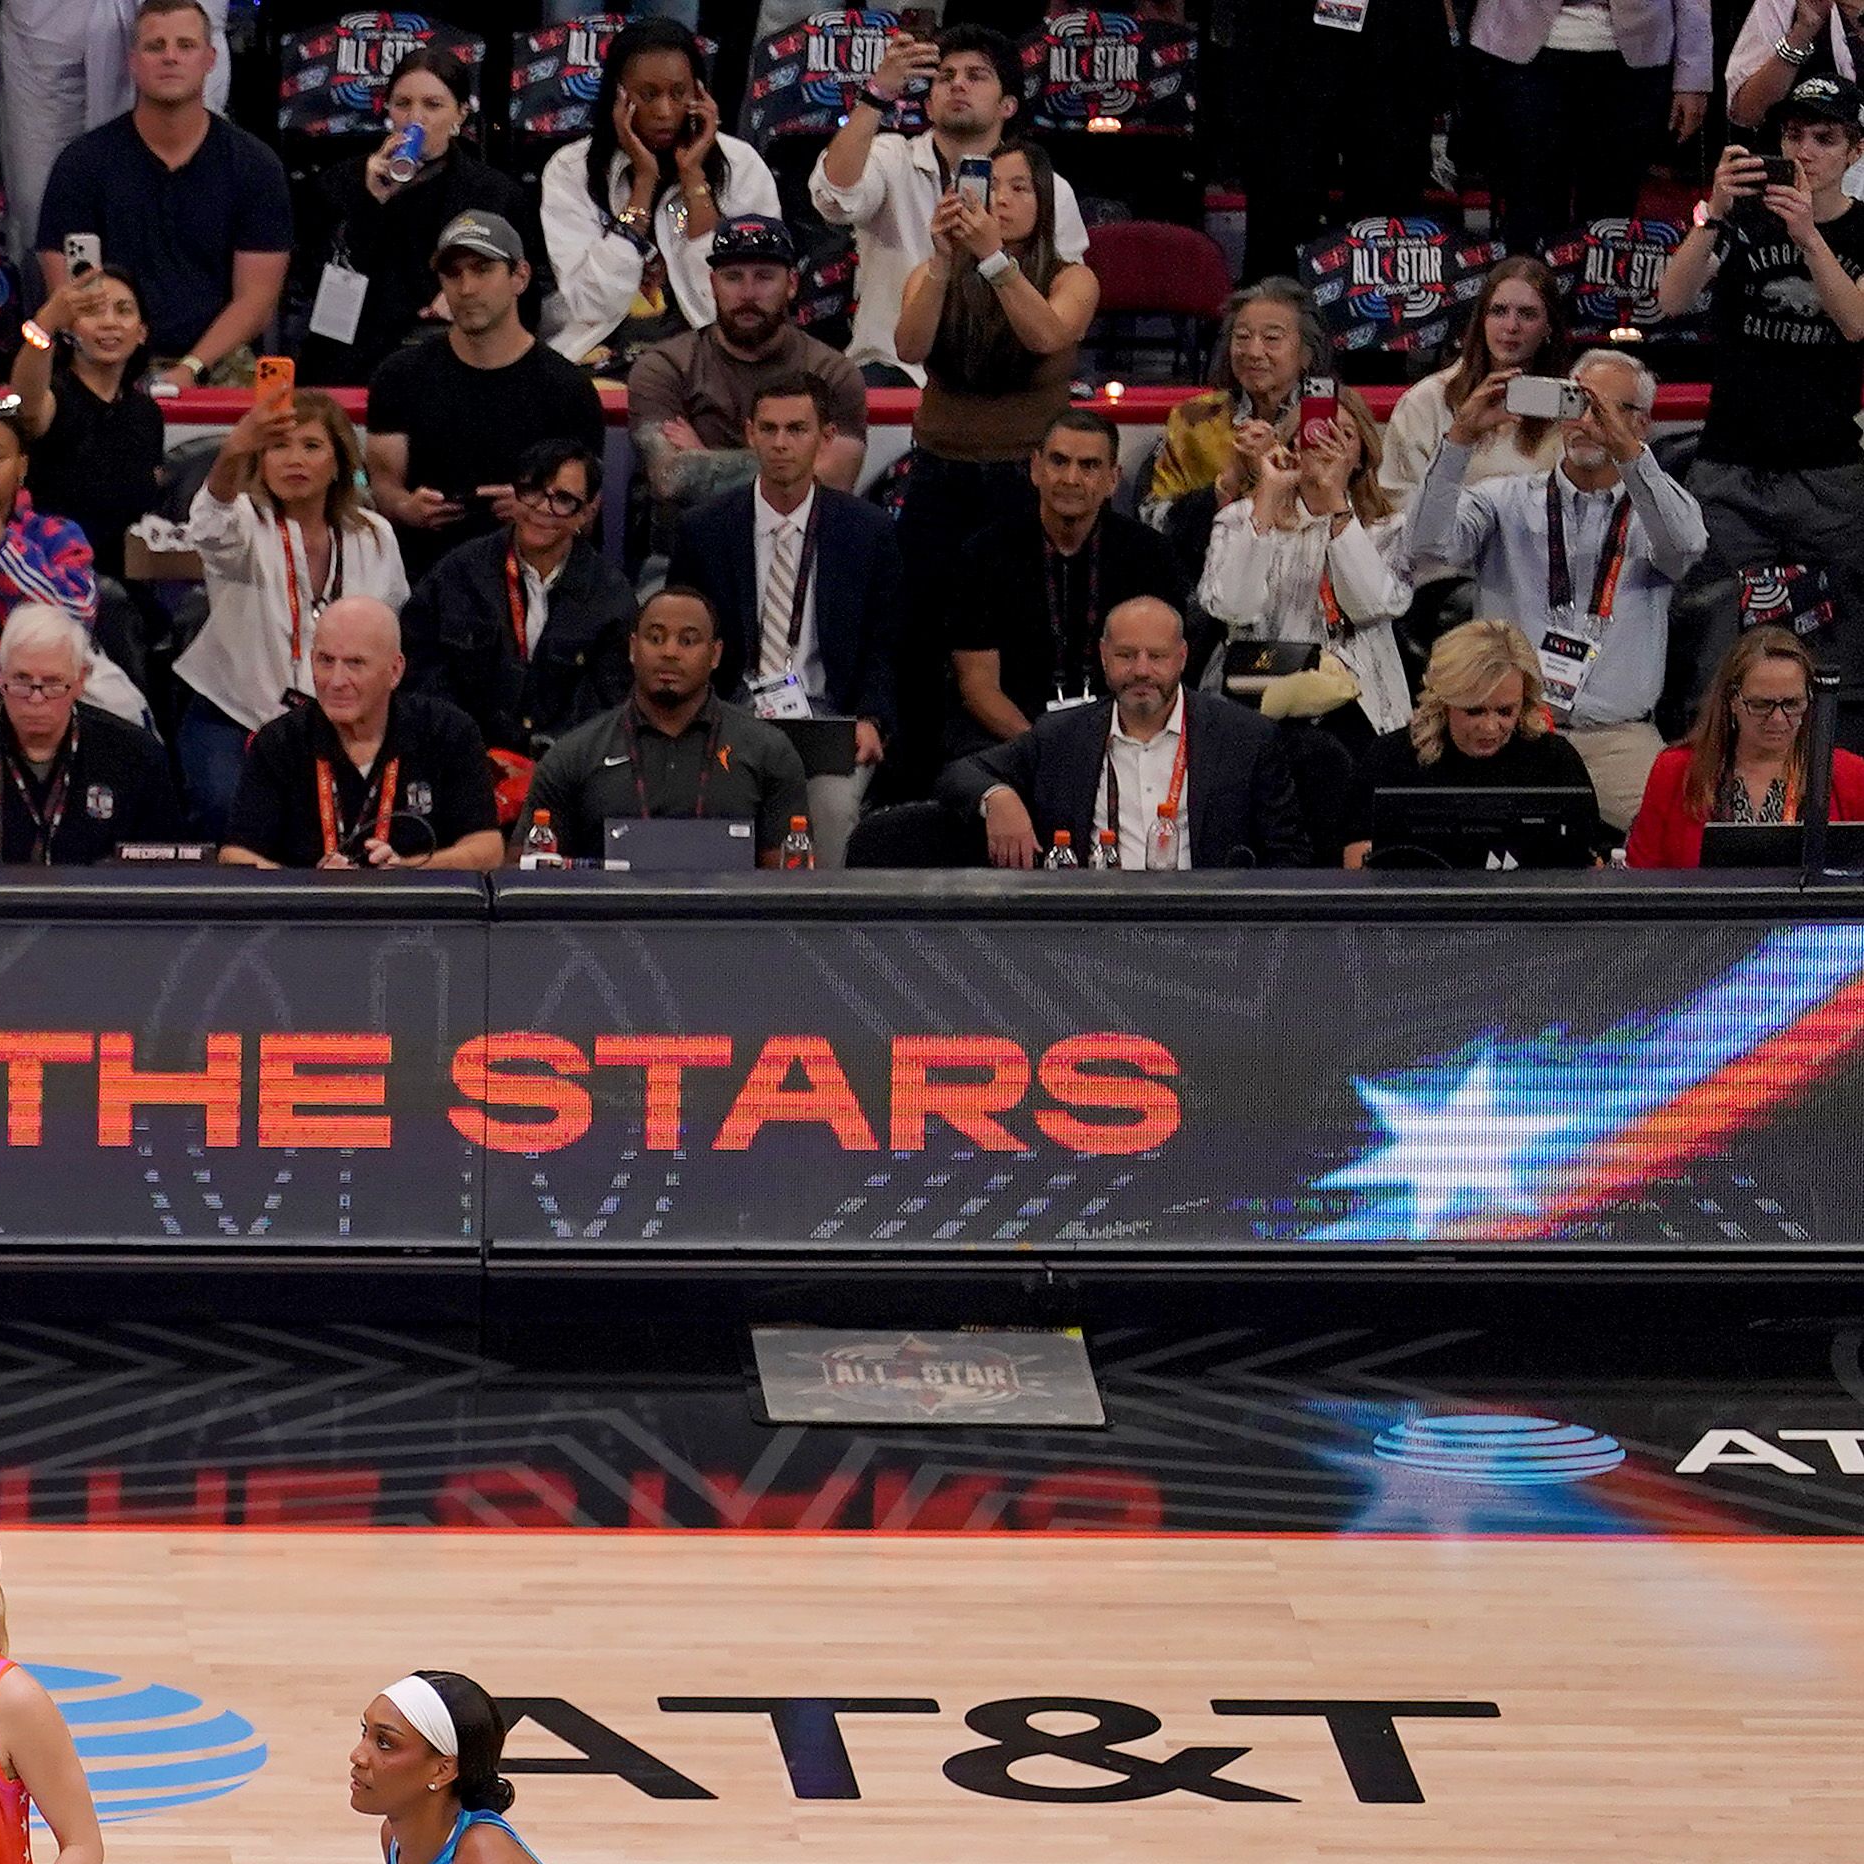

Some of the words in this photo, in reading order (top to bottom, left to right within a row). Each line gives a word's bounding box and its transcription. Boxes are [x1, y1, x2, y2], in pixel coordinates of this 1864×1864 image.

[1049, 46, 1082, 82] ALL
[1093, 46, 1139, 82] STAR
[1353, 246, 1384, 284] ALL
[1396, 245, 1443, 284] STAR
[1585, 246, 1616, 286] ALL
[1630, 250, 1673, 290] STA
[447, 1031, 1181, 1155] STARS
[501, 1696, 1502, 1804] AT&T
